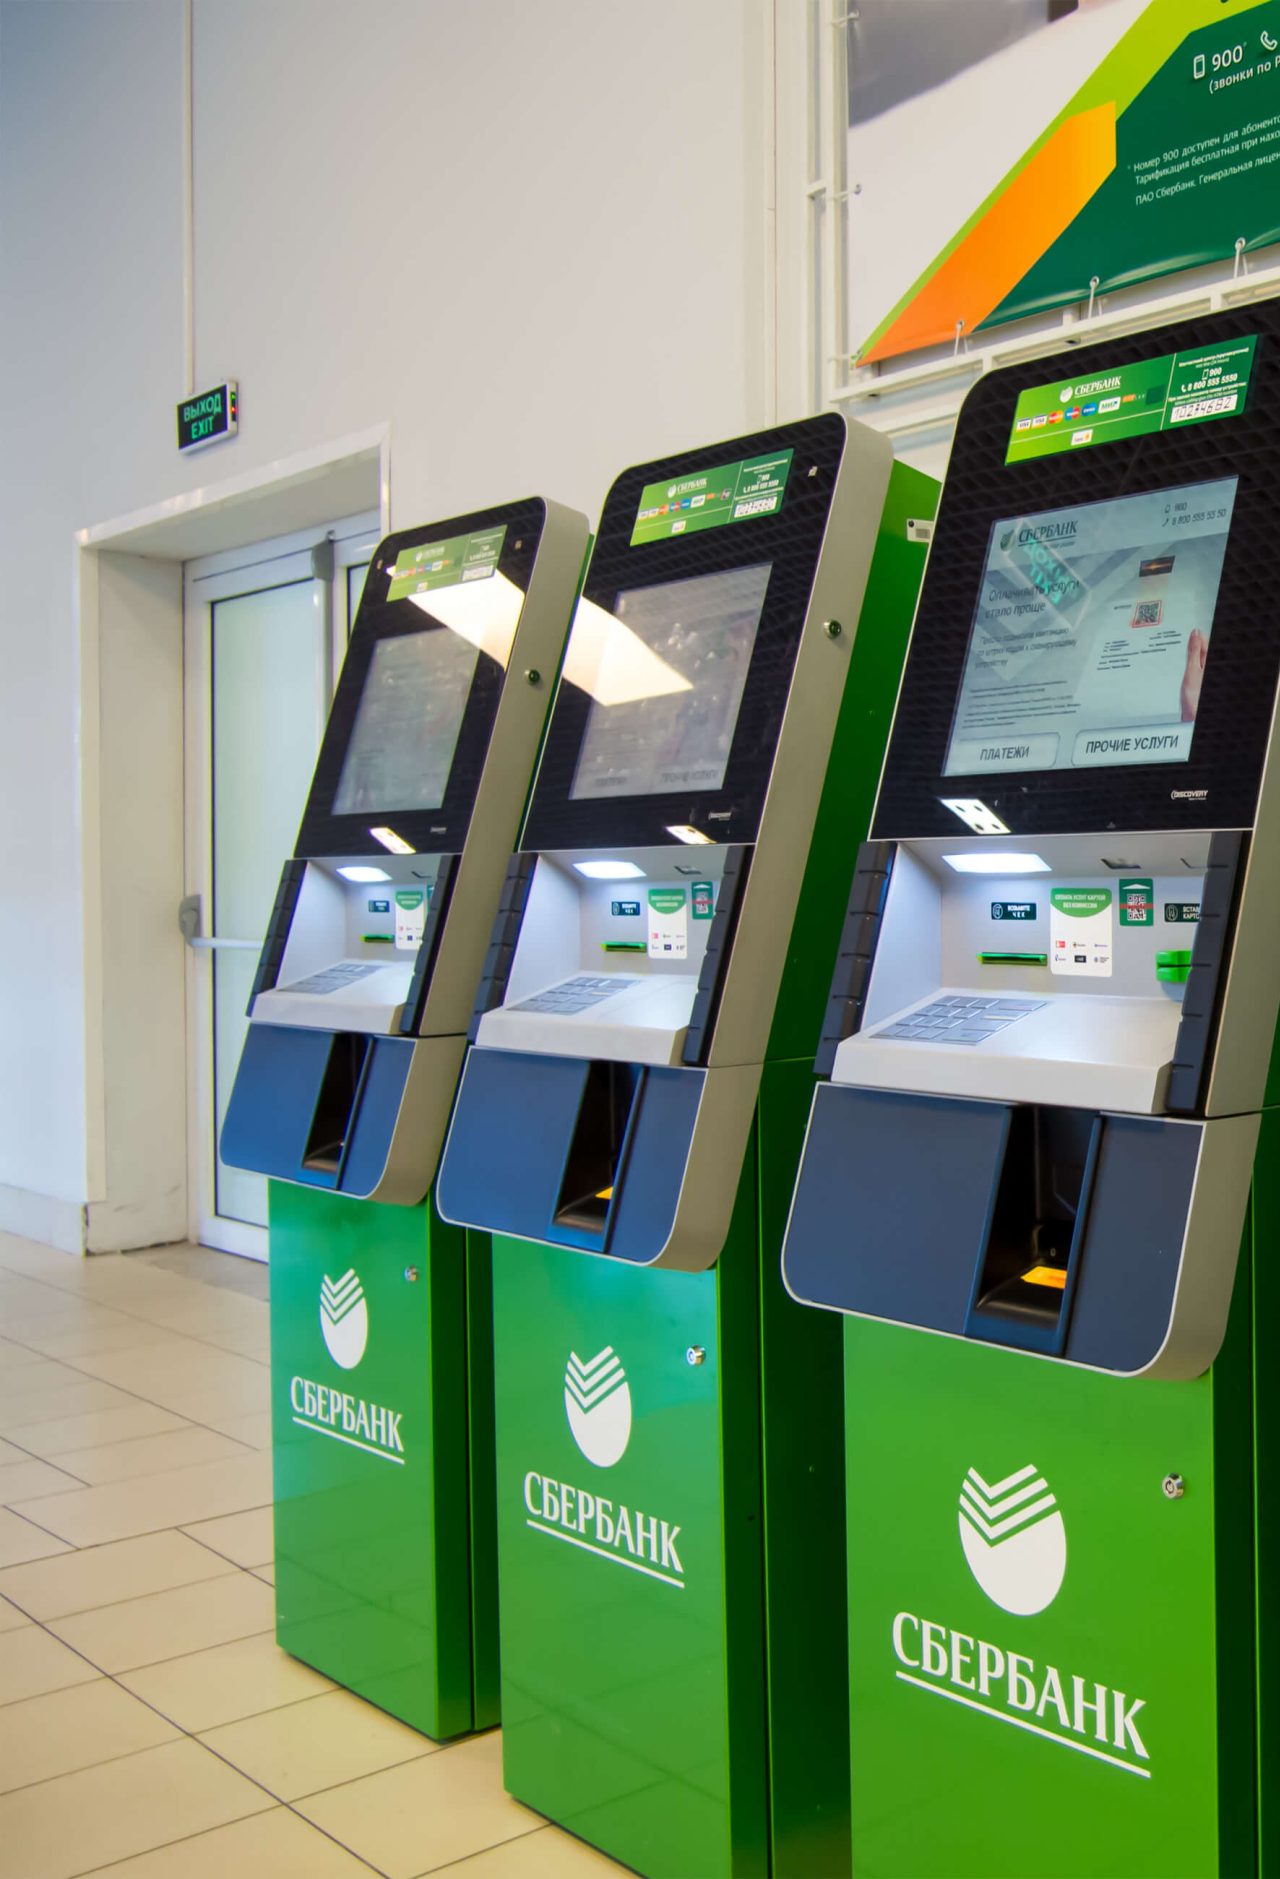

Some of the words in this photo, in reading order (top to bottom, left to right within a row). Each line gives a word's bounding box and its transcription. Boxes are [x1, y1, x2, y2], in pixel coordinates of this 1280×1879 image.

[1209, 68, 1253, 94] (звонки
[1257, 62, 1271, 76] по
[1134, 156, 1160, 172] Номер
[1162, 149, 1179, 163] 900
[1181, 137, 1220, 157] доступен
[1223, 130, 1239, 143] для
[1135, 160, 1189, 185] Тарификация
[1191, 144, 1239, 166] бесплатная
[1241, 138, 1258, 151] при
[1135, 192, 1153, 206] ПАО
[1199, 160, 1252, 185] Генеральная
[1074, 376, 1121, 396] СБЕРБАНК
[184, 393, 222, 422] ВЫХОД
[192, 416, 214, 439] EXIT
[980, 746, 1029, 761] ПЛАТЕЖИ
[1086, 738, 1131, 754] ПРОЧИЕ
[1134, 735, 1179, 750] УСЛУГИ
[291, 1375, 405, 1453] СБЕРБАНК
[523, 1471, 684, 1573] СБЕРБАНК
[892, 1611, 1150, 1760] СБЕРБАНК
